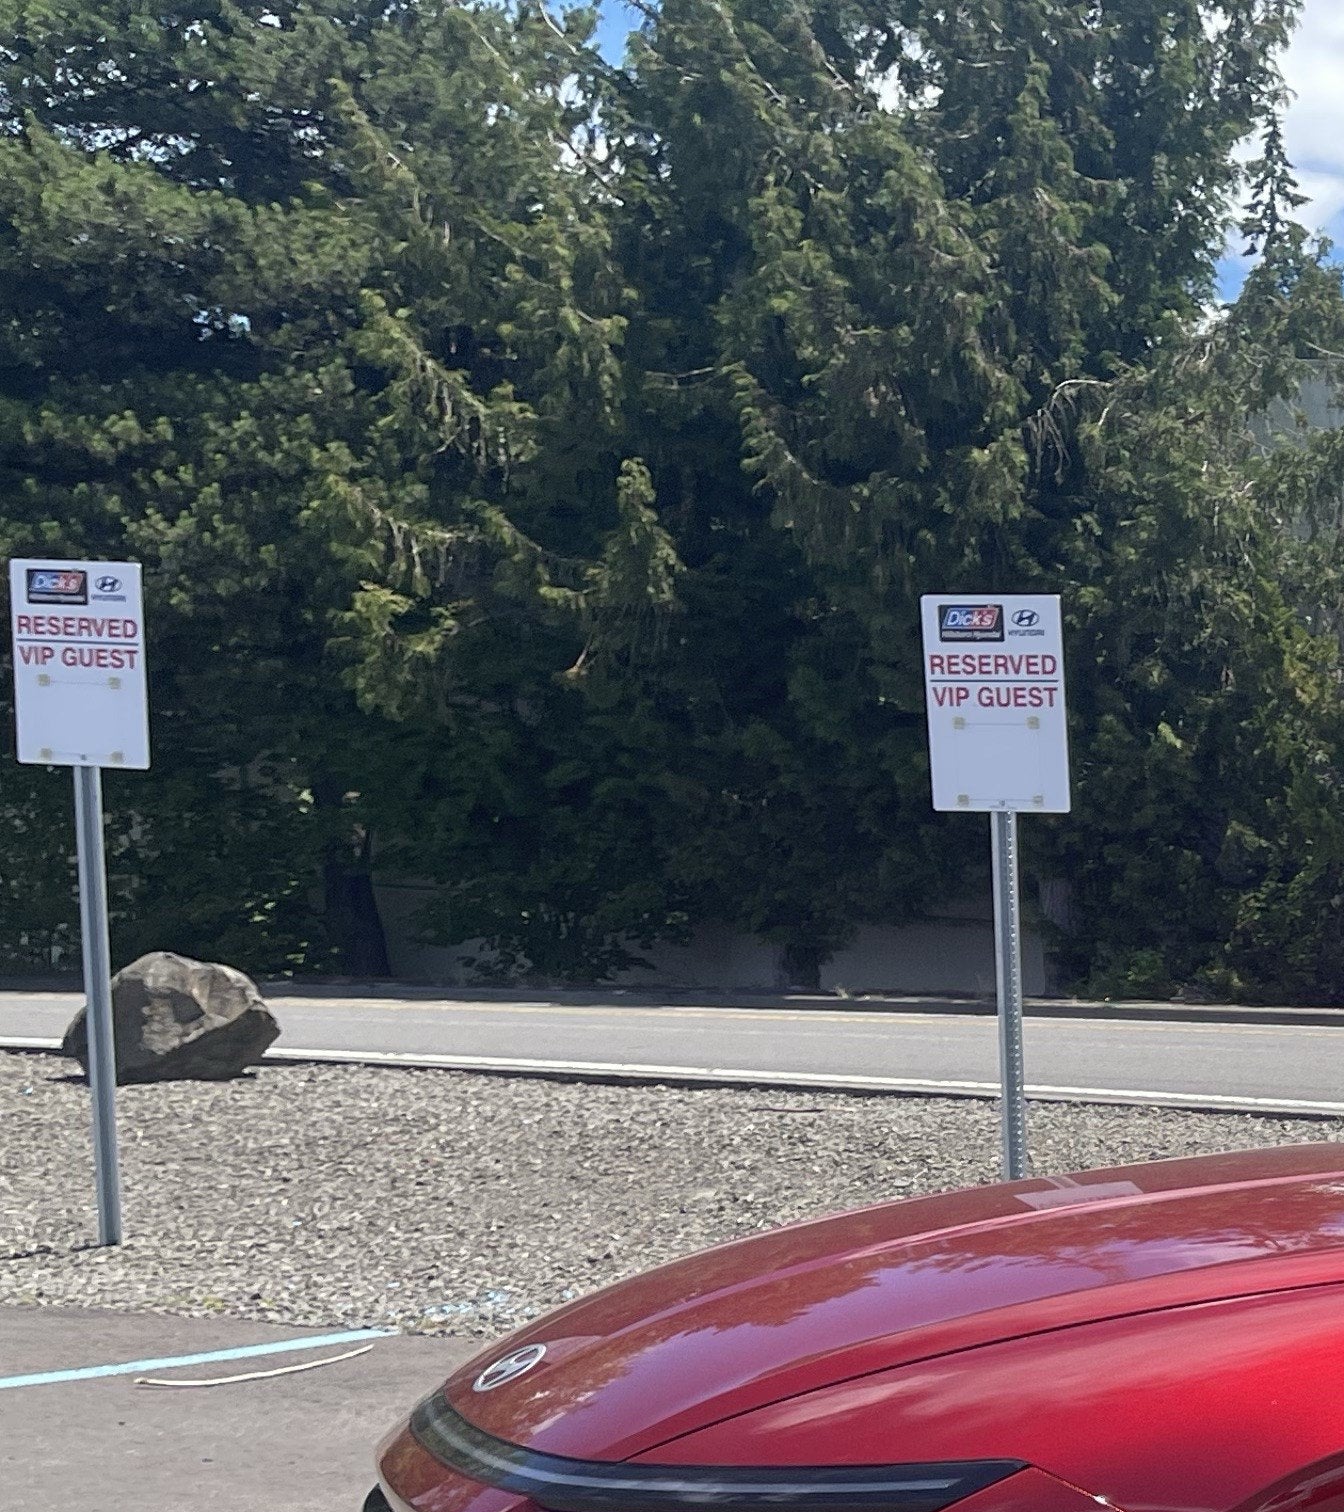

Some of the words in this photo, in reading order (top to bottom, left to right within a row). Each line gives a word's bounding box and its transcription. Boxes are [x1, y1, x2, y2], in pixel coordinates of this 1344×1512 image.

[17, 615, 138, 638] RESERVED
[18, 645, 54, 665] VIP
[61, 648, 139, 669] GUEST
[929, 655, 1057, 675] RESERVED
[932, 687, 969, 707] VIP
[978, 687, 1058, 707] GUEST
